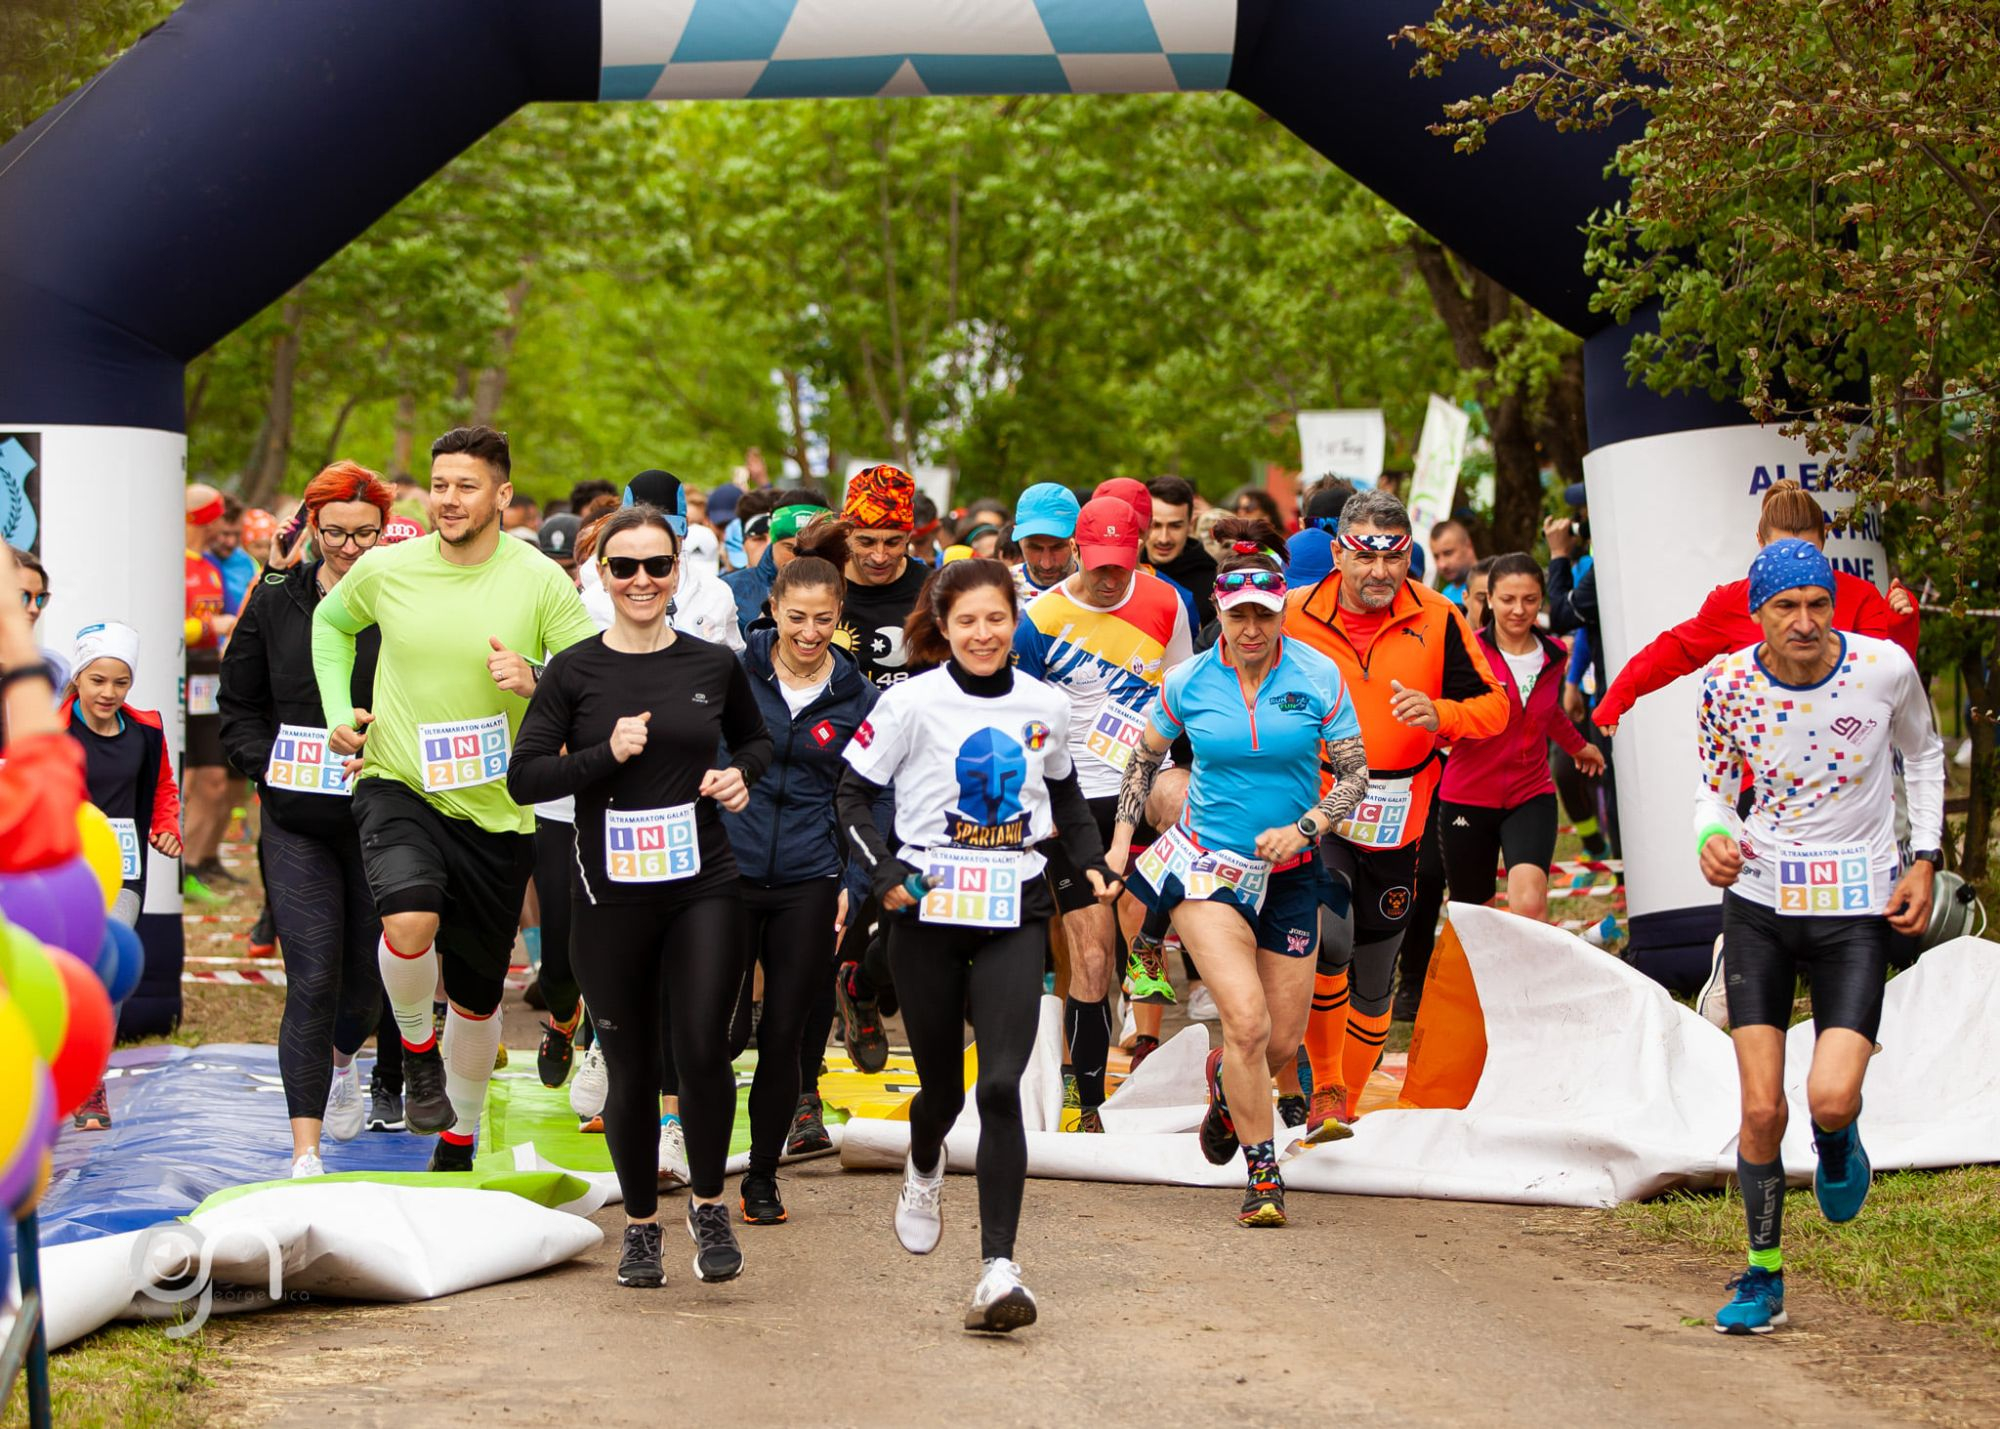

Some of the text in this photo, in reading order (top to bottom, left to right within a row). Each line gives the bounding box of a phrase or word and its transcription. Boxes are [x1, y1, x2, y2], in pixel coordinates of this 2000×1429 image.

[425, 725, 480, 736] ULTRAMARATON
[432, 759, 502, 784] 269
[609, 814, 665, 824] ULTRAMARATON
[616, 850, 690, 874] 263
[931, 894, 1010, 919] 218
[1787, 888, 1865, 908] 282
